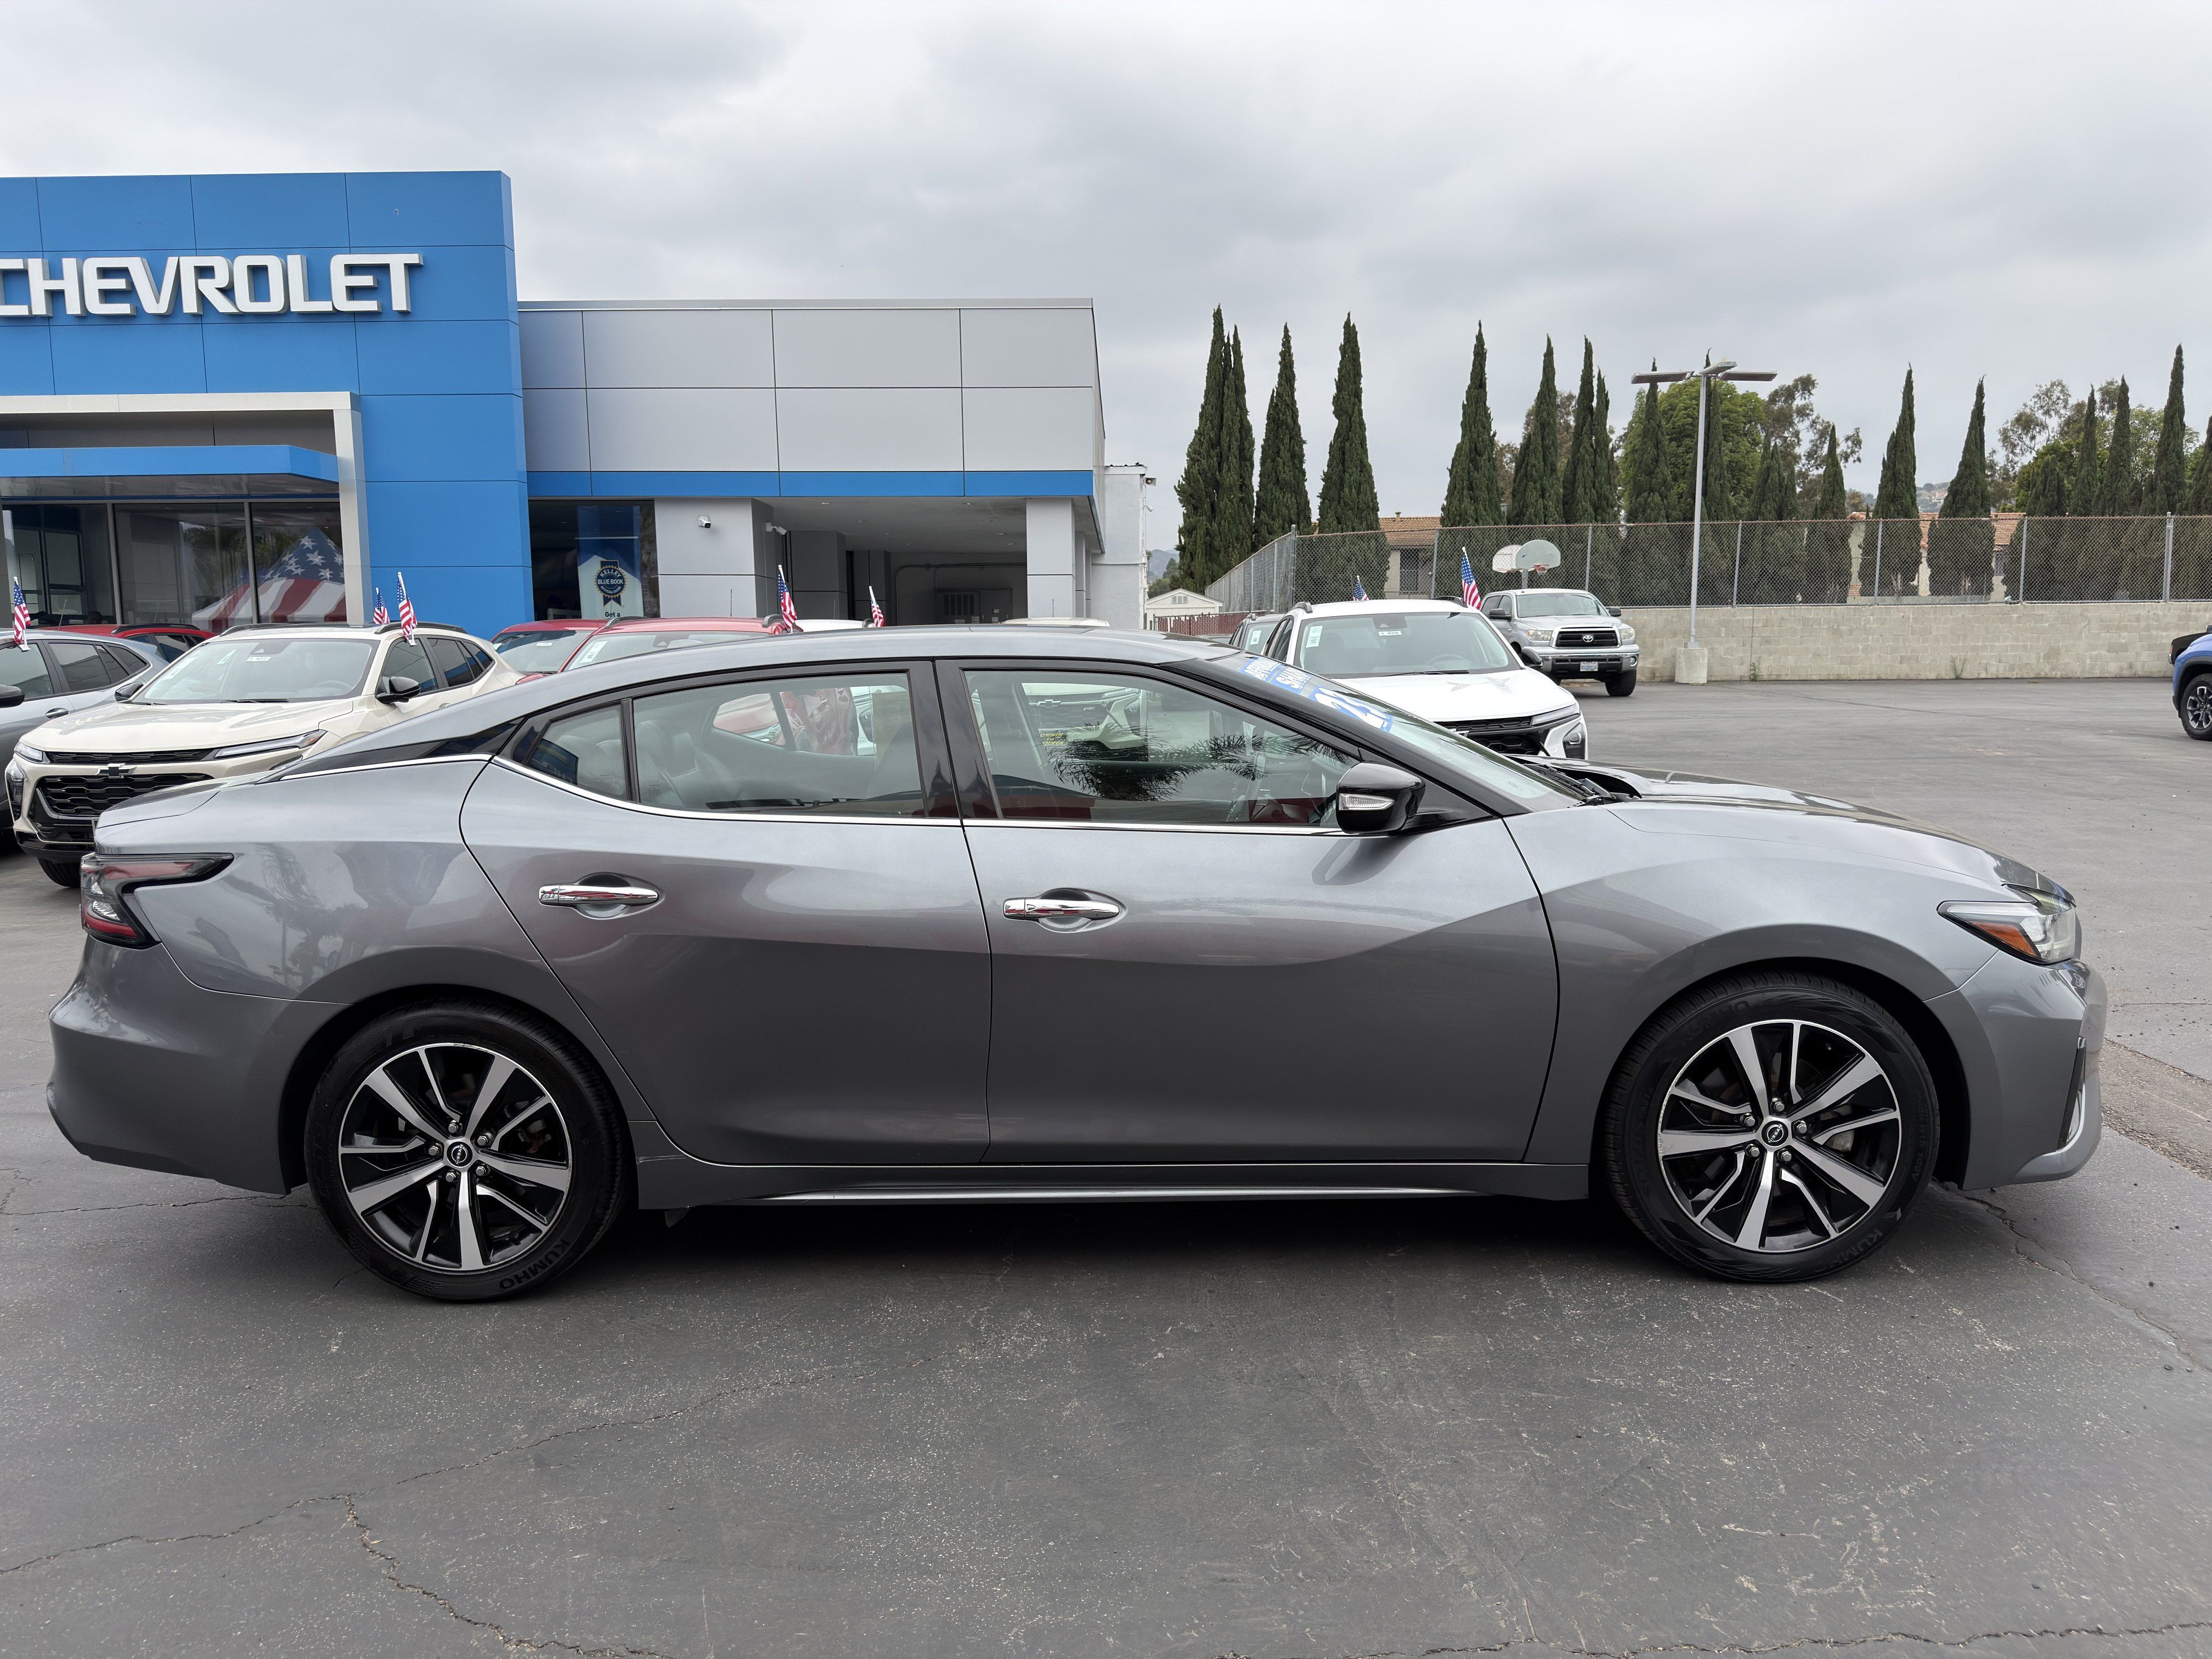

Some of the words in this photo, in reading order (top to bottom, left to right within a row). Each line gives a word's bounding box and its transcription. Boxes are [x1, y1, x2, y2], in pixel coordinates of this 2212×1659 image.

[0, 253, 423, 317] CHEVROLET
[600, 569, 621, 577] KELLEY
[1768, 1124, 1782, 1143] NISSAN
[499, 1238, 571, 1289] KUMHO
